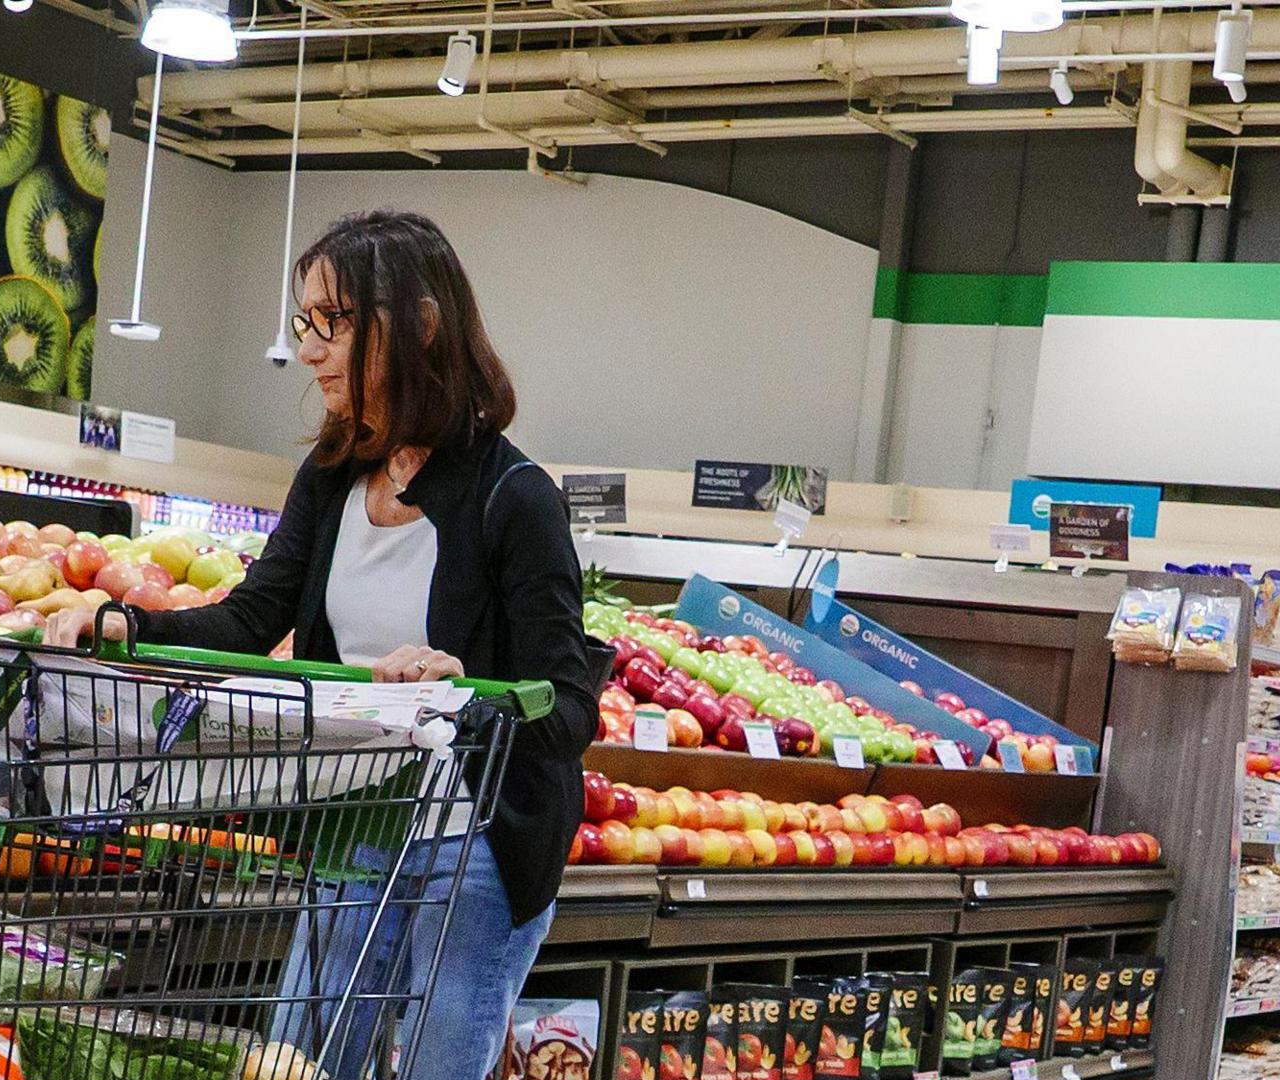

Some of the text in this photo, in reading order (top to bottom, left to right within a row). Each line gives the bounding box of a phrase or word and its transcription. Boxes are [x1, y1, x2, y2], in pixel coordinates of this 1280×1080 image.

[742, 612, 804, 653] ORGANIC
[861, 629, 919, 669] ORGANIC
[1063, 972, 1087, 991] re
[789, 999, 817, 1021] re
[828, 992, 857, 1015] re
[893, 989, 918, 1008] re
[738, 999, 780, 1024] are
